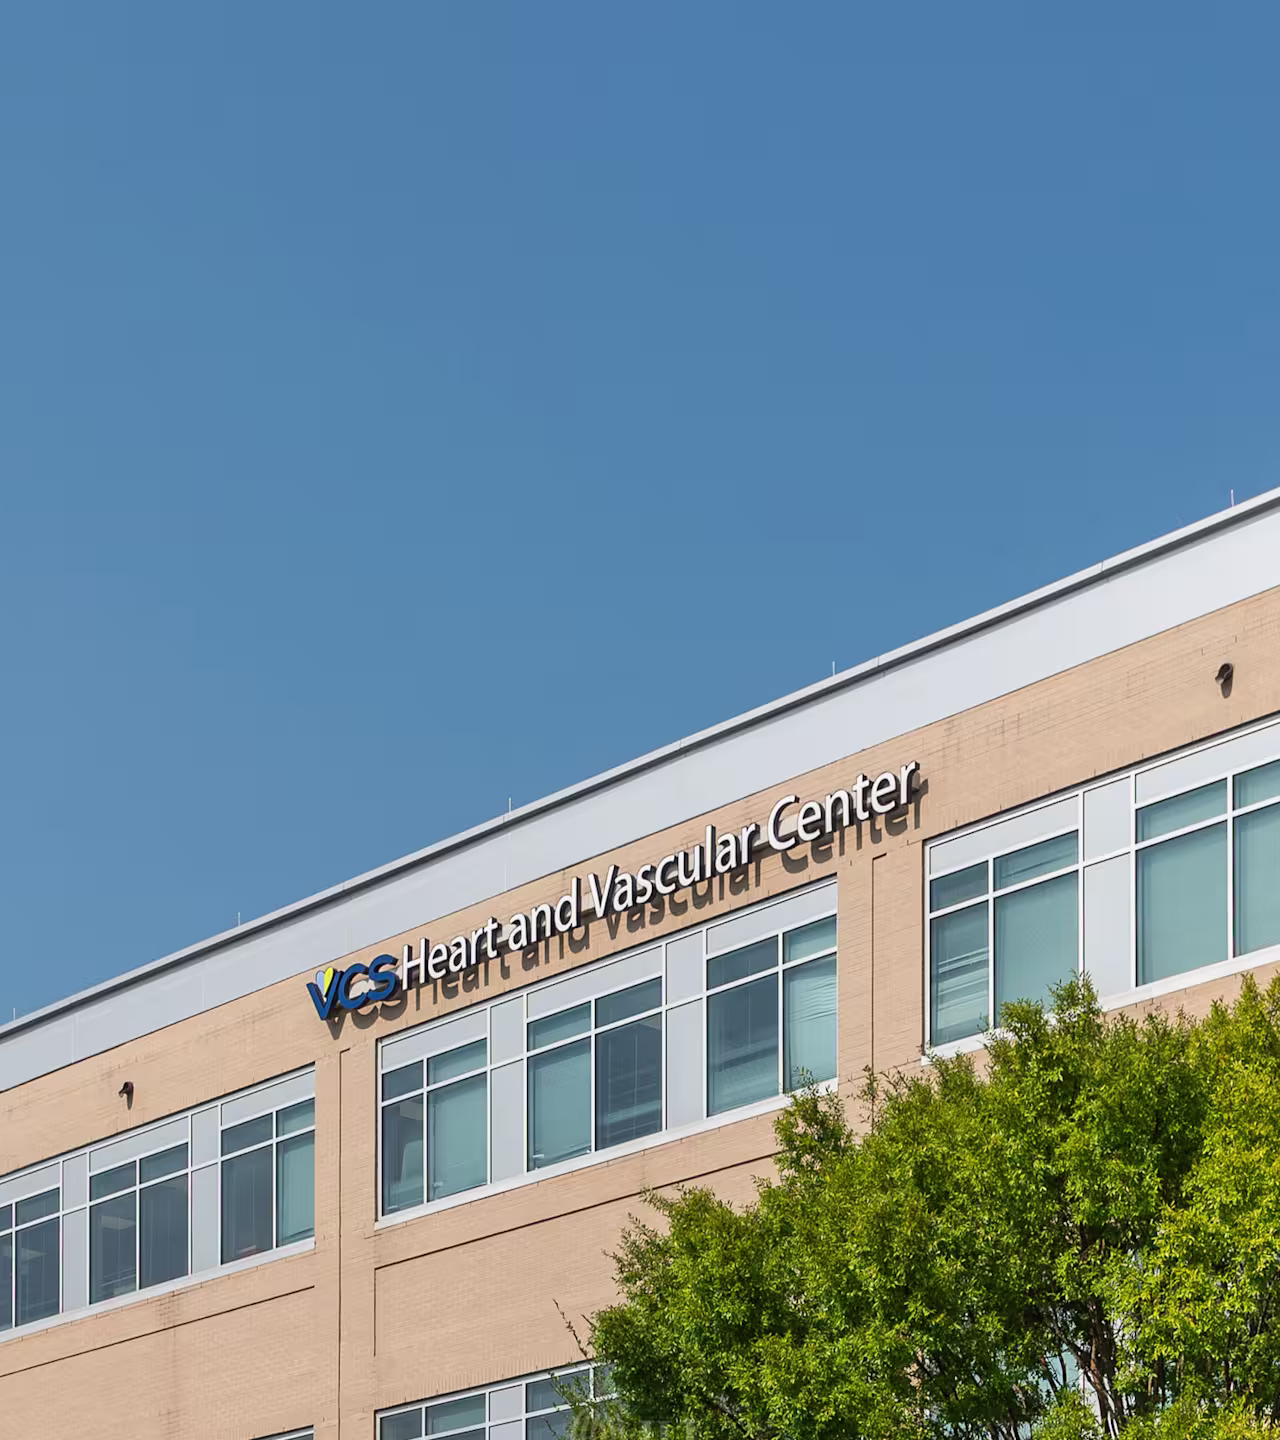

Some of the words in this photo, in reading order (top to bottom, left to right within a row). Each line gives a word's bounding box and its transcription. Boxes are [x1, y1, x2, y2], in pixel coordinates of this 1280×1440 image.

[306, 953, 399, 1020] VCS
[400, 916, 500, 991] Heart
[507, 876, 582, 951] and
[588, 823, 758, 919] Vascular
[766, 760, 922, 852] Center
